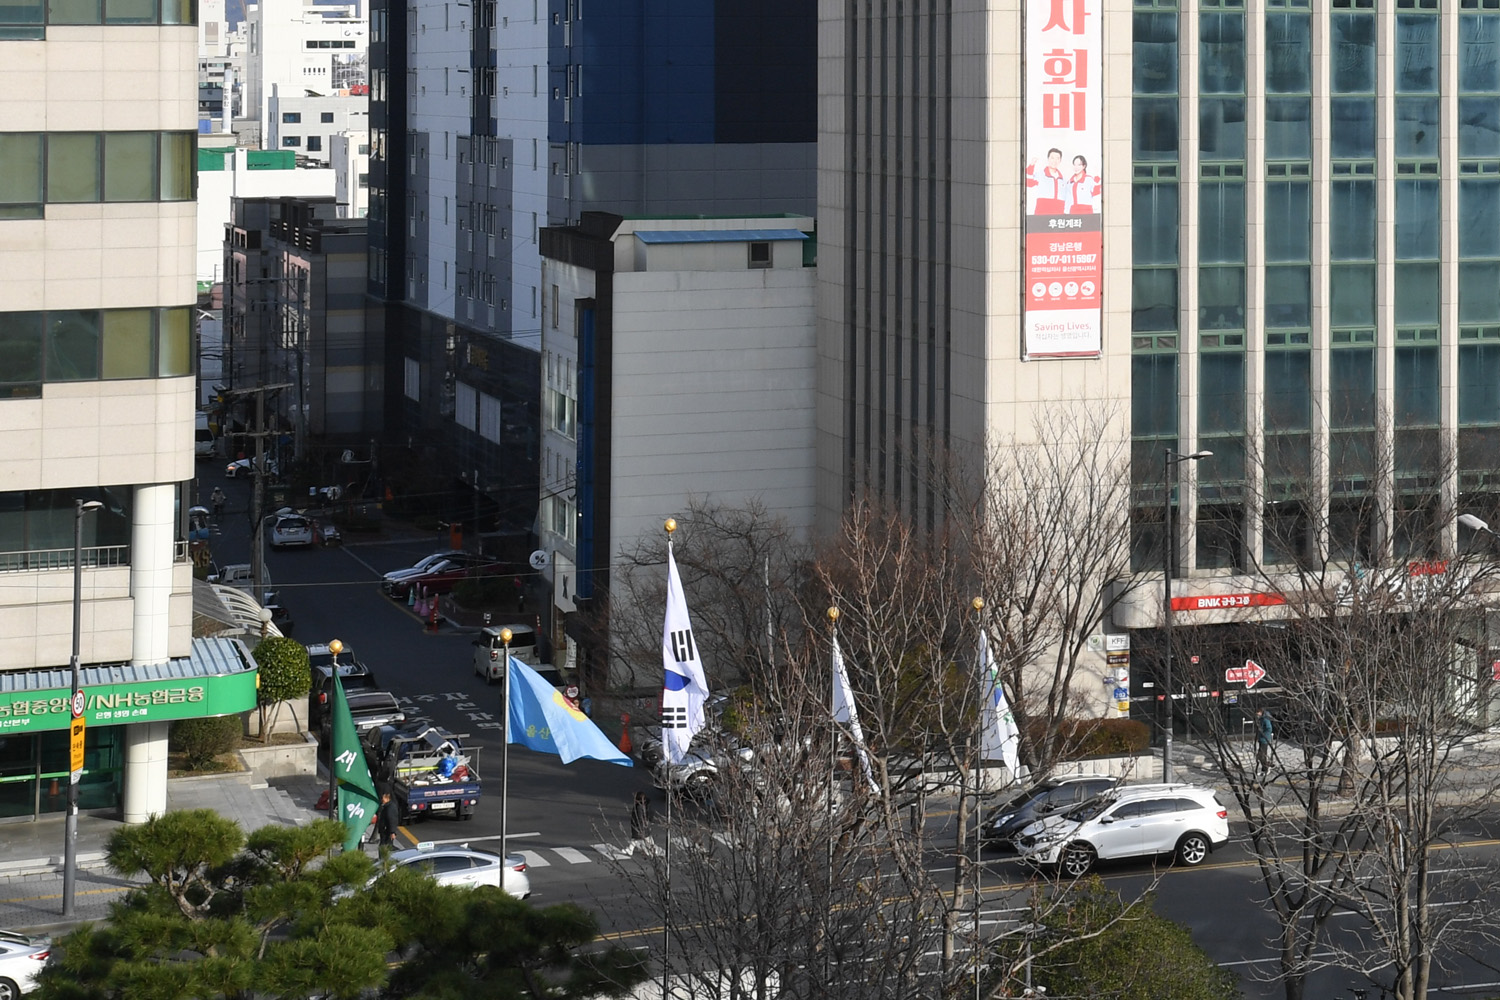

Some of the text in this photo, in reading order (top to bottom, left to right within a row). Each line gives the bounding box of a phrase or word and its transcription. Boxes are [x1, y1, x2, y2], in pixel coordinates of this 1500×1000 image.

[1042, 48, 1088, 132] 회비
[1048, 218, 1083, 229] 후원계좌
[1049, 242, 1083, 252] 경남은행
[1034, 323, 1065, 334] Saving
[0, 718, 31, 728] 산본부
[95, 711, 112, 720] 은행
